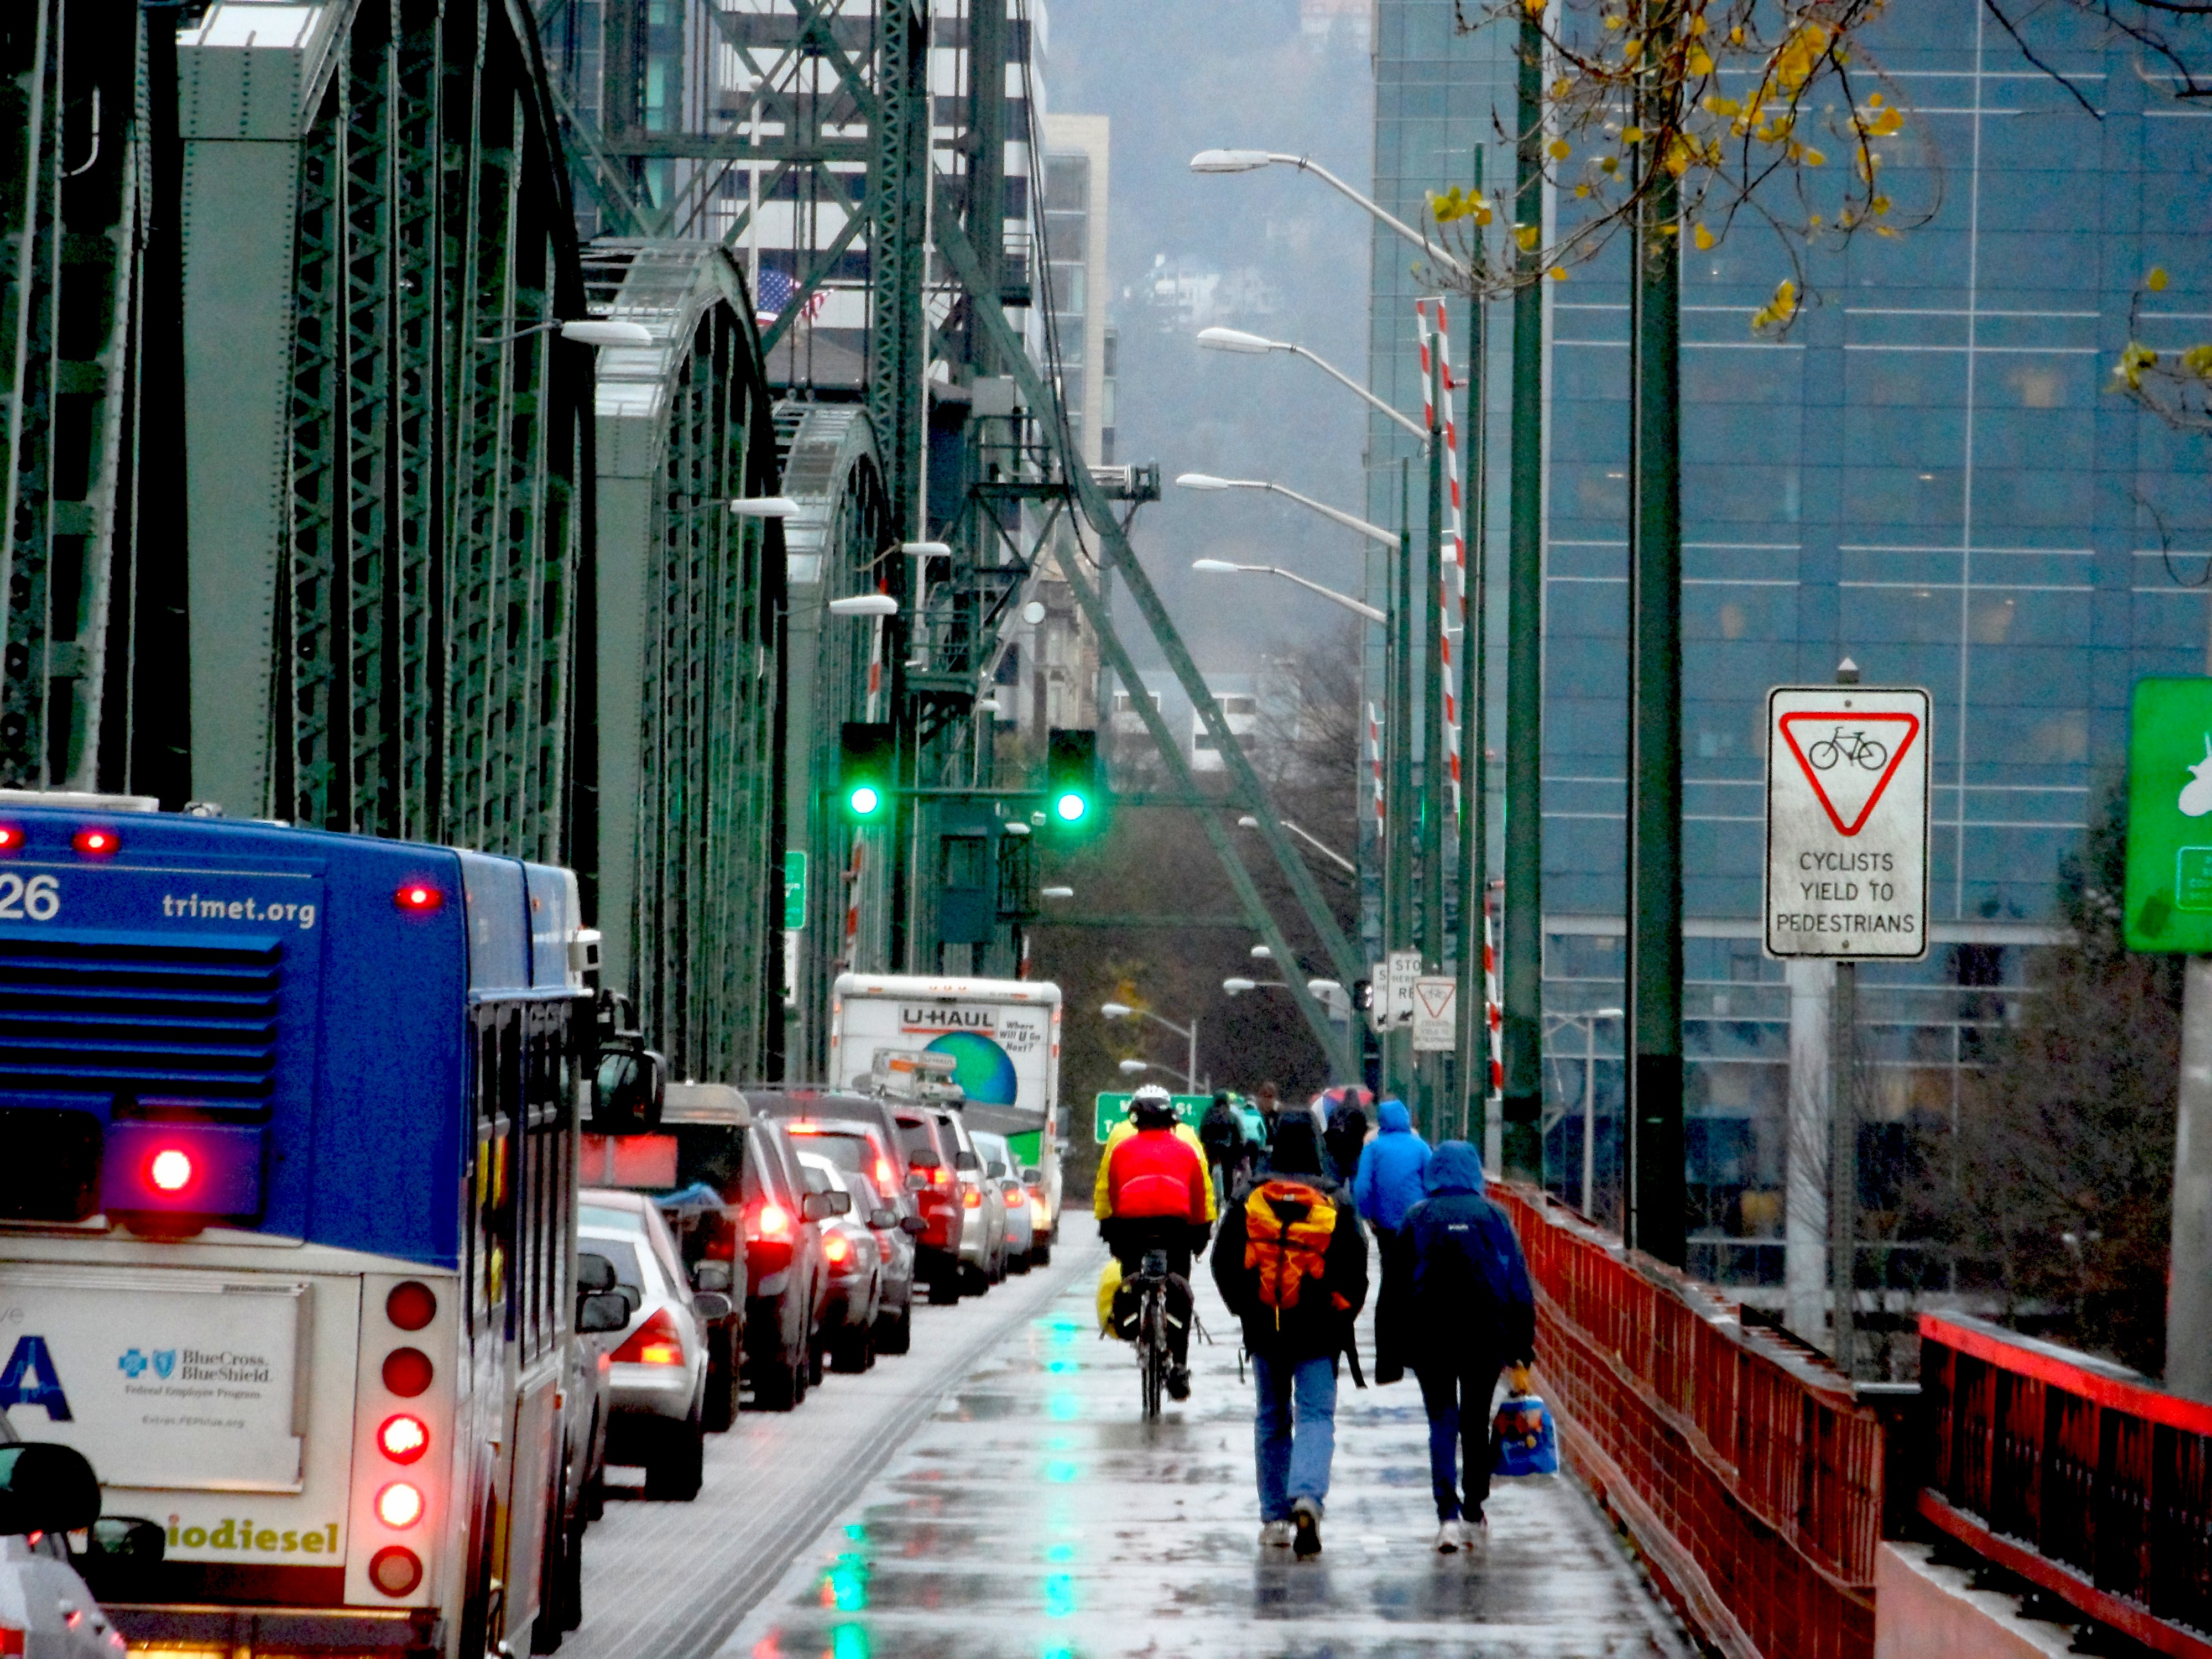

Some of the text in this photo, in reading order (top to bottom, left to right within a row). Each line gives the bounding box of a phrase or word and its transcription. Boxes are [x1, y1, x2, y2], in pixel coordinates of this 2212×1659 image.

[1800, 852, 1893, 872] CYCLISTS
[1801, 880, 1893, 901] YIELD TO
[0, 873, 315, 929] 26 trimet.org
[1777, 914, 1914, 933] PEDESTRIANS
[1396, 959, 1421, 971] STO
[903, 1009, 994, 1027] U-HAUL
[168, 1514, 338, 1554] iodiesel
